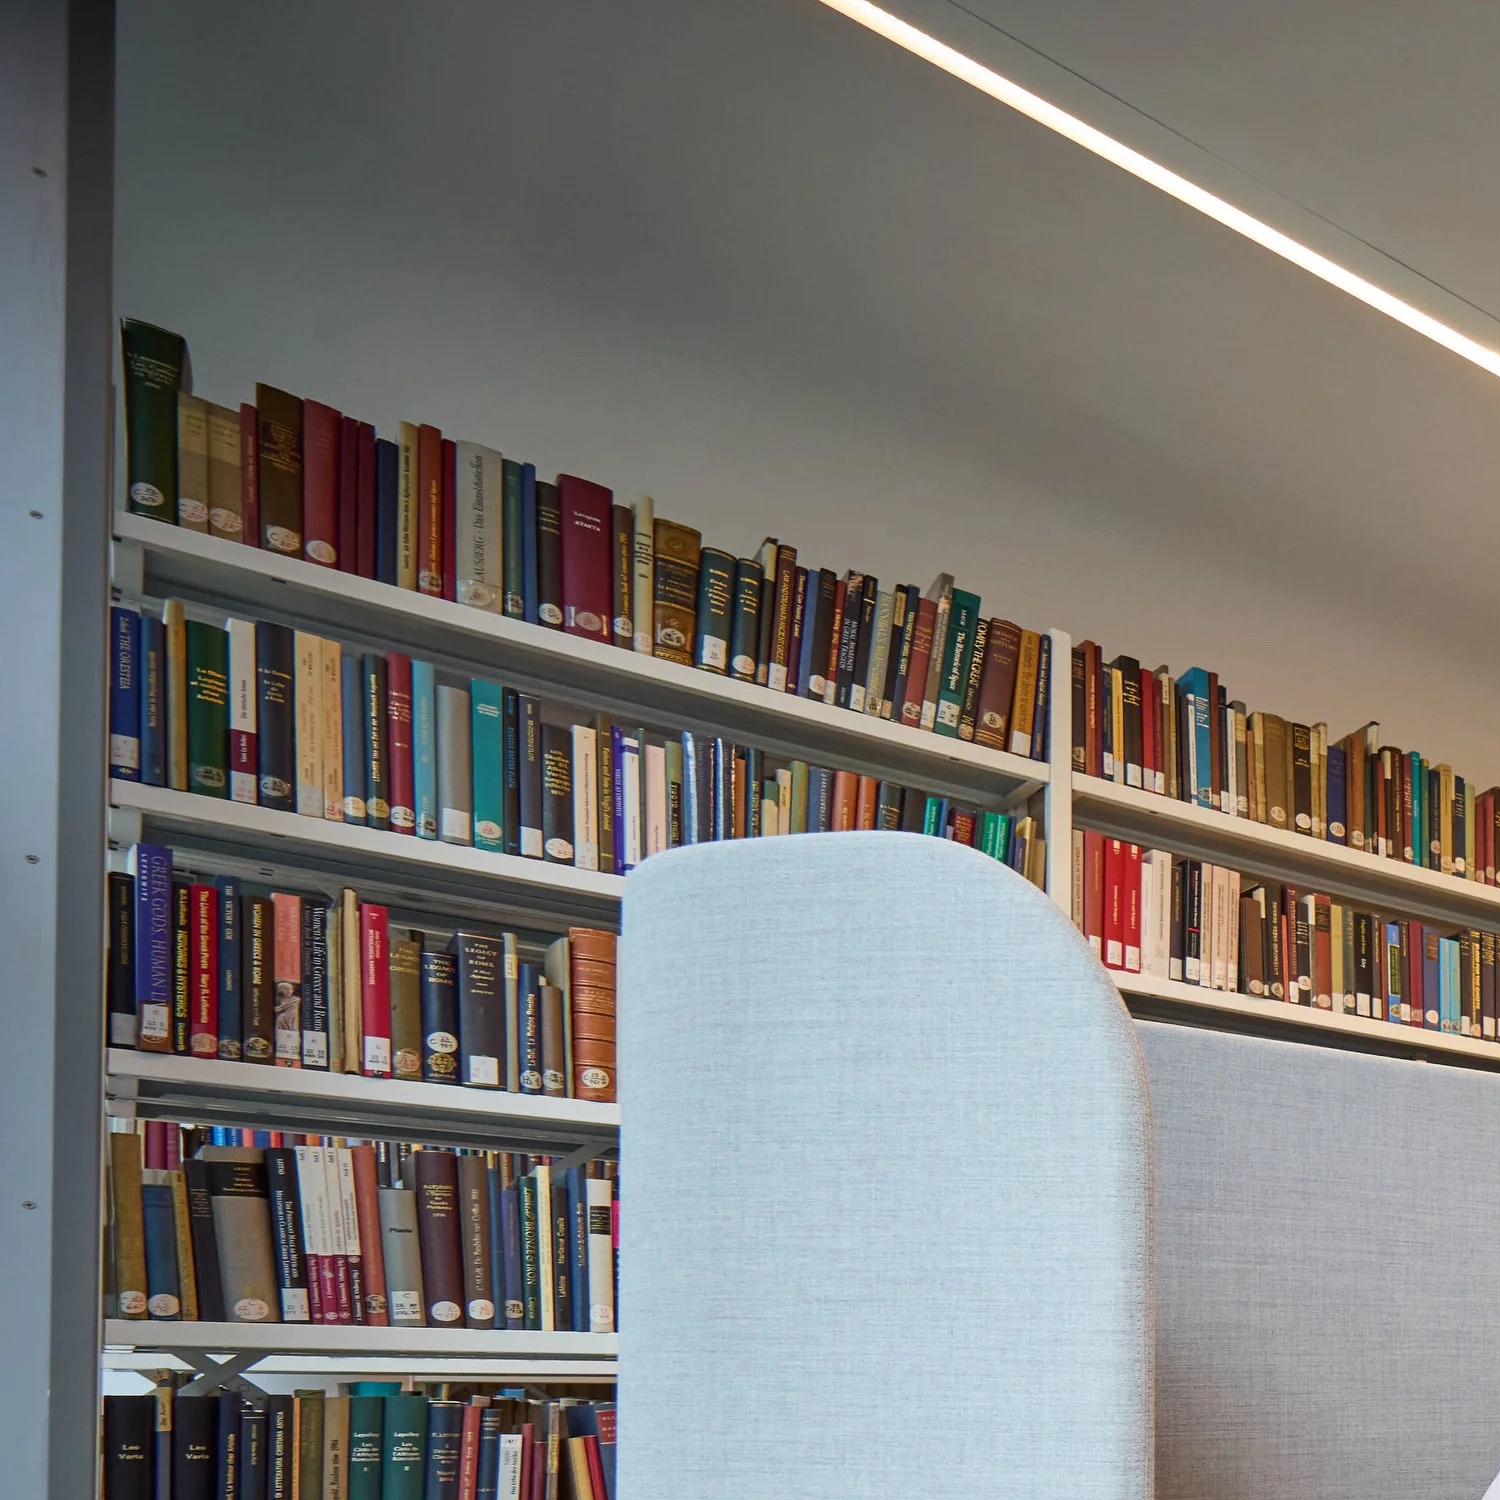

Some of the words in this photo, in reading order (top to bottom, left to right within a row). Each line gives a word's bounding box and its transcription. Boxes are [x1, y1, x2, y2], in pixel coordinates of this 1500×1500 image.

[472, 513, 484, 529] Das
[473, 537, 484, 584] LAUSBERG
[120, 636, 130, 650] THE
[956, 632, 964, 640] The
[953, 641, 963, 666] Rhetoric
[120, 652, 130, 689] ORESTEIA
[949, 674, 959, 691] Space
[152, 856, 167, 894] GREEK
[253, 904, 262, 928] WOMEN
[314, 907, 324, 940] Women's
[177, 930, 188, 967] HEROINES
[253, 938, 262, 960] GREECE
[314, 942, 324, 956] Life
[465, 948, 498, 956] LEGACY
[152, 940, 167, 988] HUMAN
[468, 960, 495, 968] ROME
[314, 966, 324, 992] Greece
[176, 976, 187, 1018] HYSTERICS
[314, 994, 324, 1009] and
